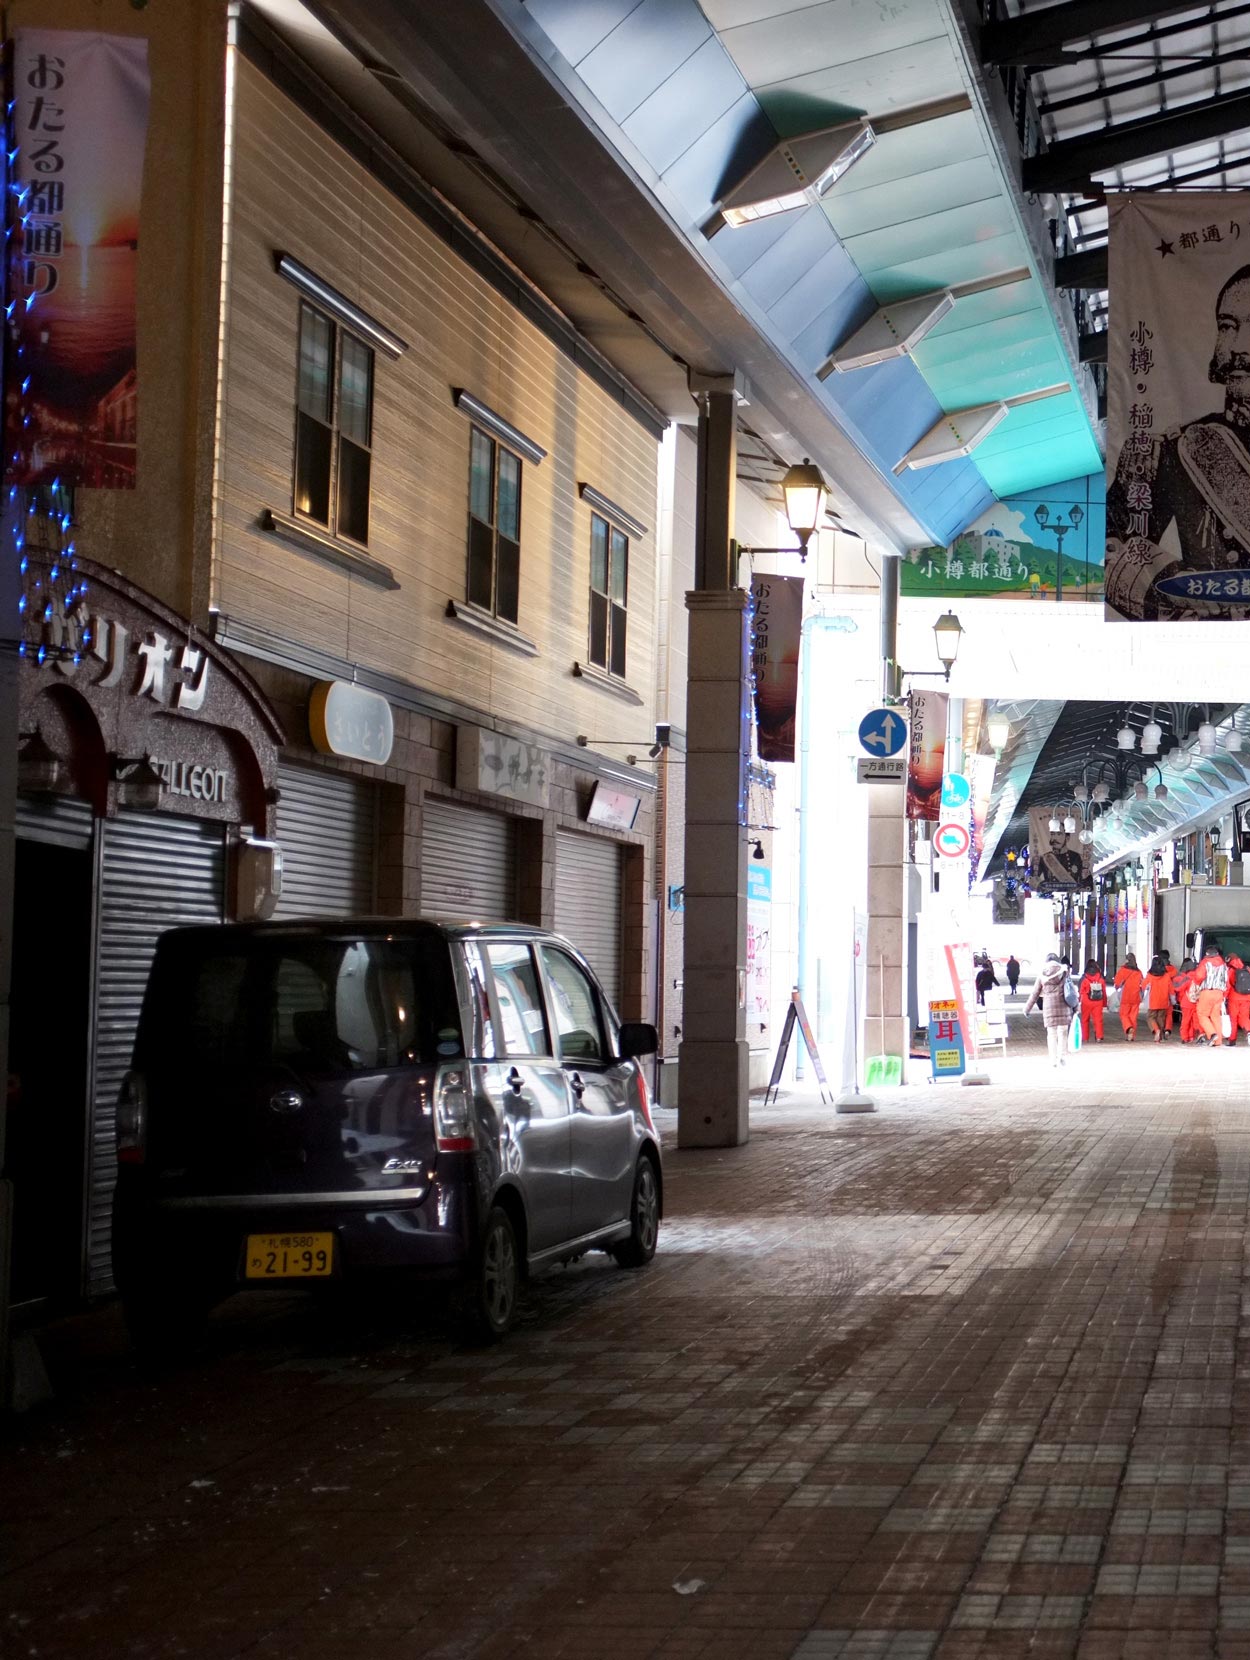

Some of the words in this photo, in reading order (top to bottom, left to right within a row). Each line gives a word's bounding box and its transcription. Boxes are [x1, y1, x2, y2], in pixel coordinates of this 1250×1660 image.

[24, 53, 66, 297] おたる都通り
[1126, 320, 1155, 567] 小樽・稲穂・梁川線
[920, 560, 1029, 581] 小樽都通り
[912, 696, 926, 767] おたる都通り
[860, 761, 904, 772] 一方通行路
[933, 1011, 958, 1020] 補聴器
[934, 1020, 958, 1042] 耳
[265, 1250, 327, 1273] 21-99
